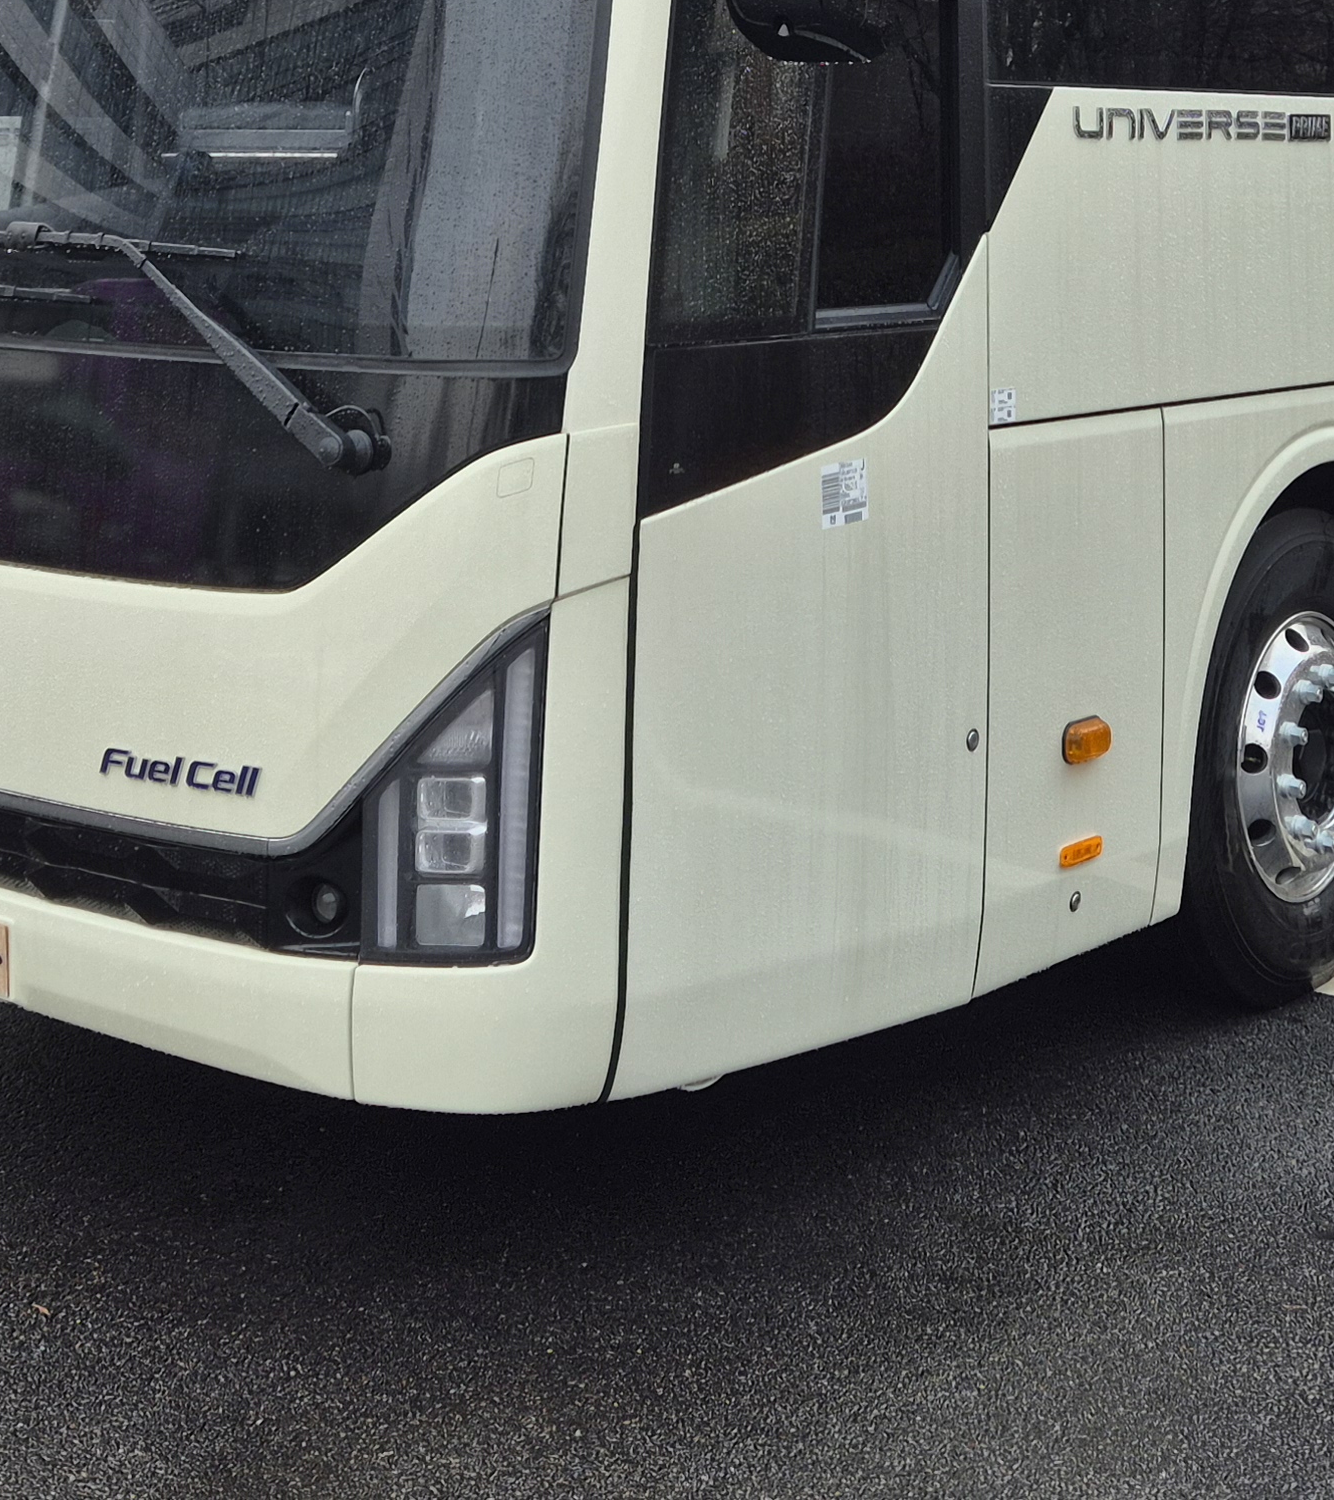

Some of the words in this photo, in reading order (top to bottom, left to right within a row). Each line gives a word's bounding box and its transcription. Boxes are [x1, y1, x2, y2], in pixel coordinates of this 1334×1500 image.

[1072, 105, 1287, 142] UNIVERSE
[99, 747, 185, 787] Fuel
[186, 760, 262, 798] Cell
